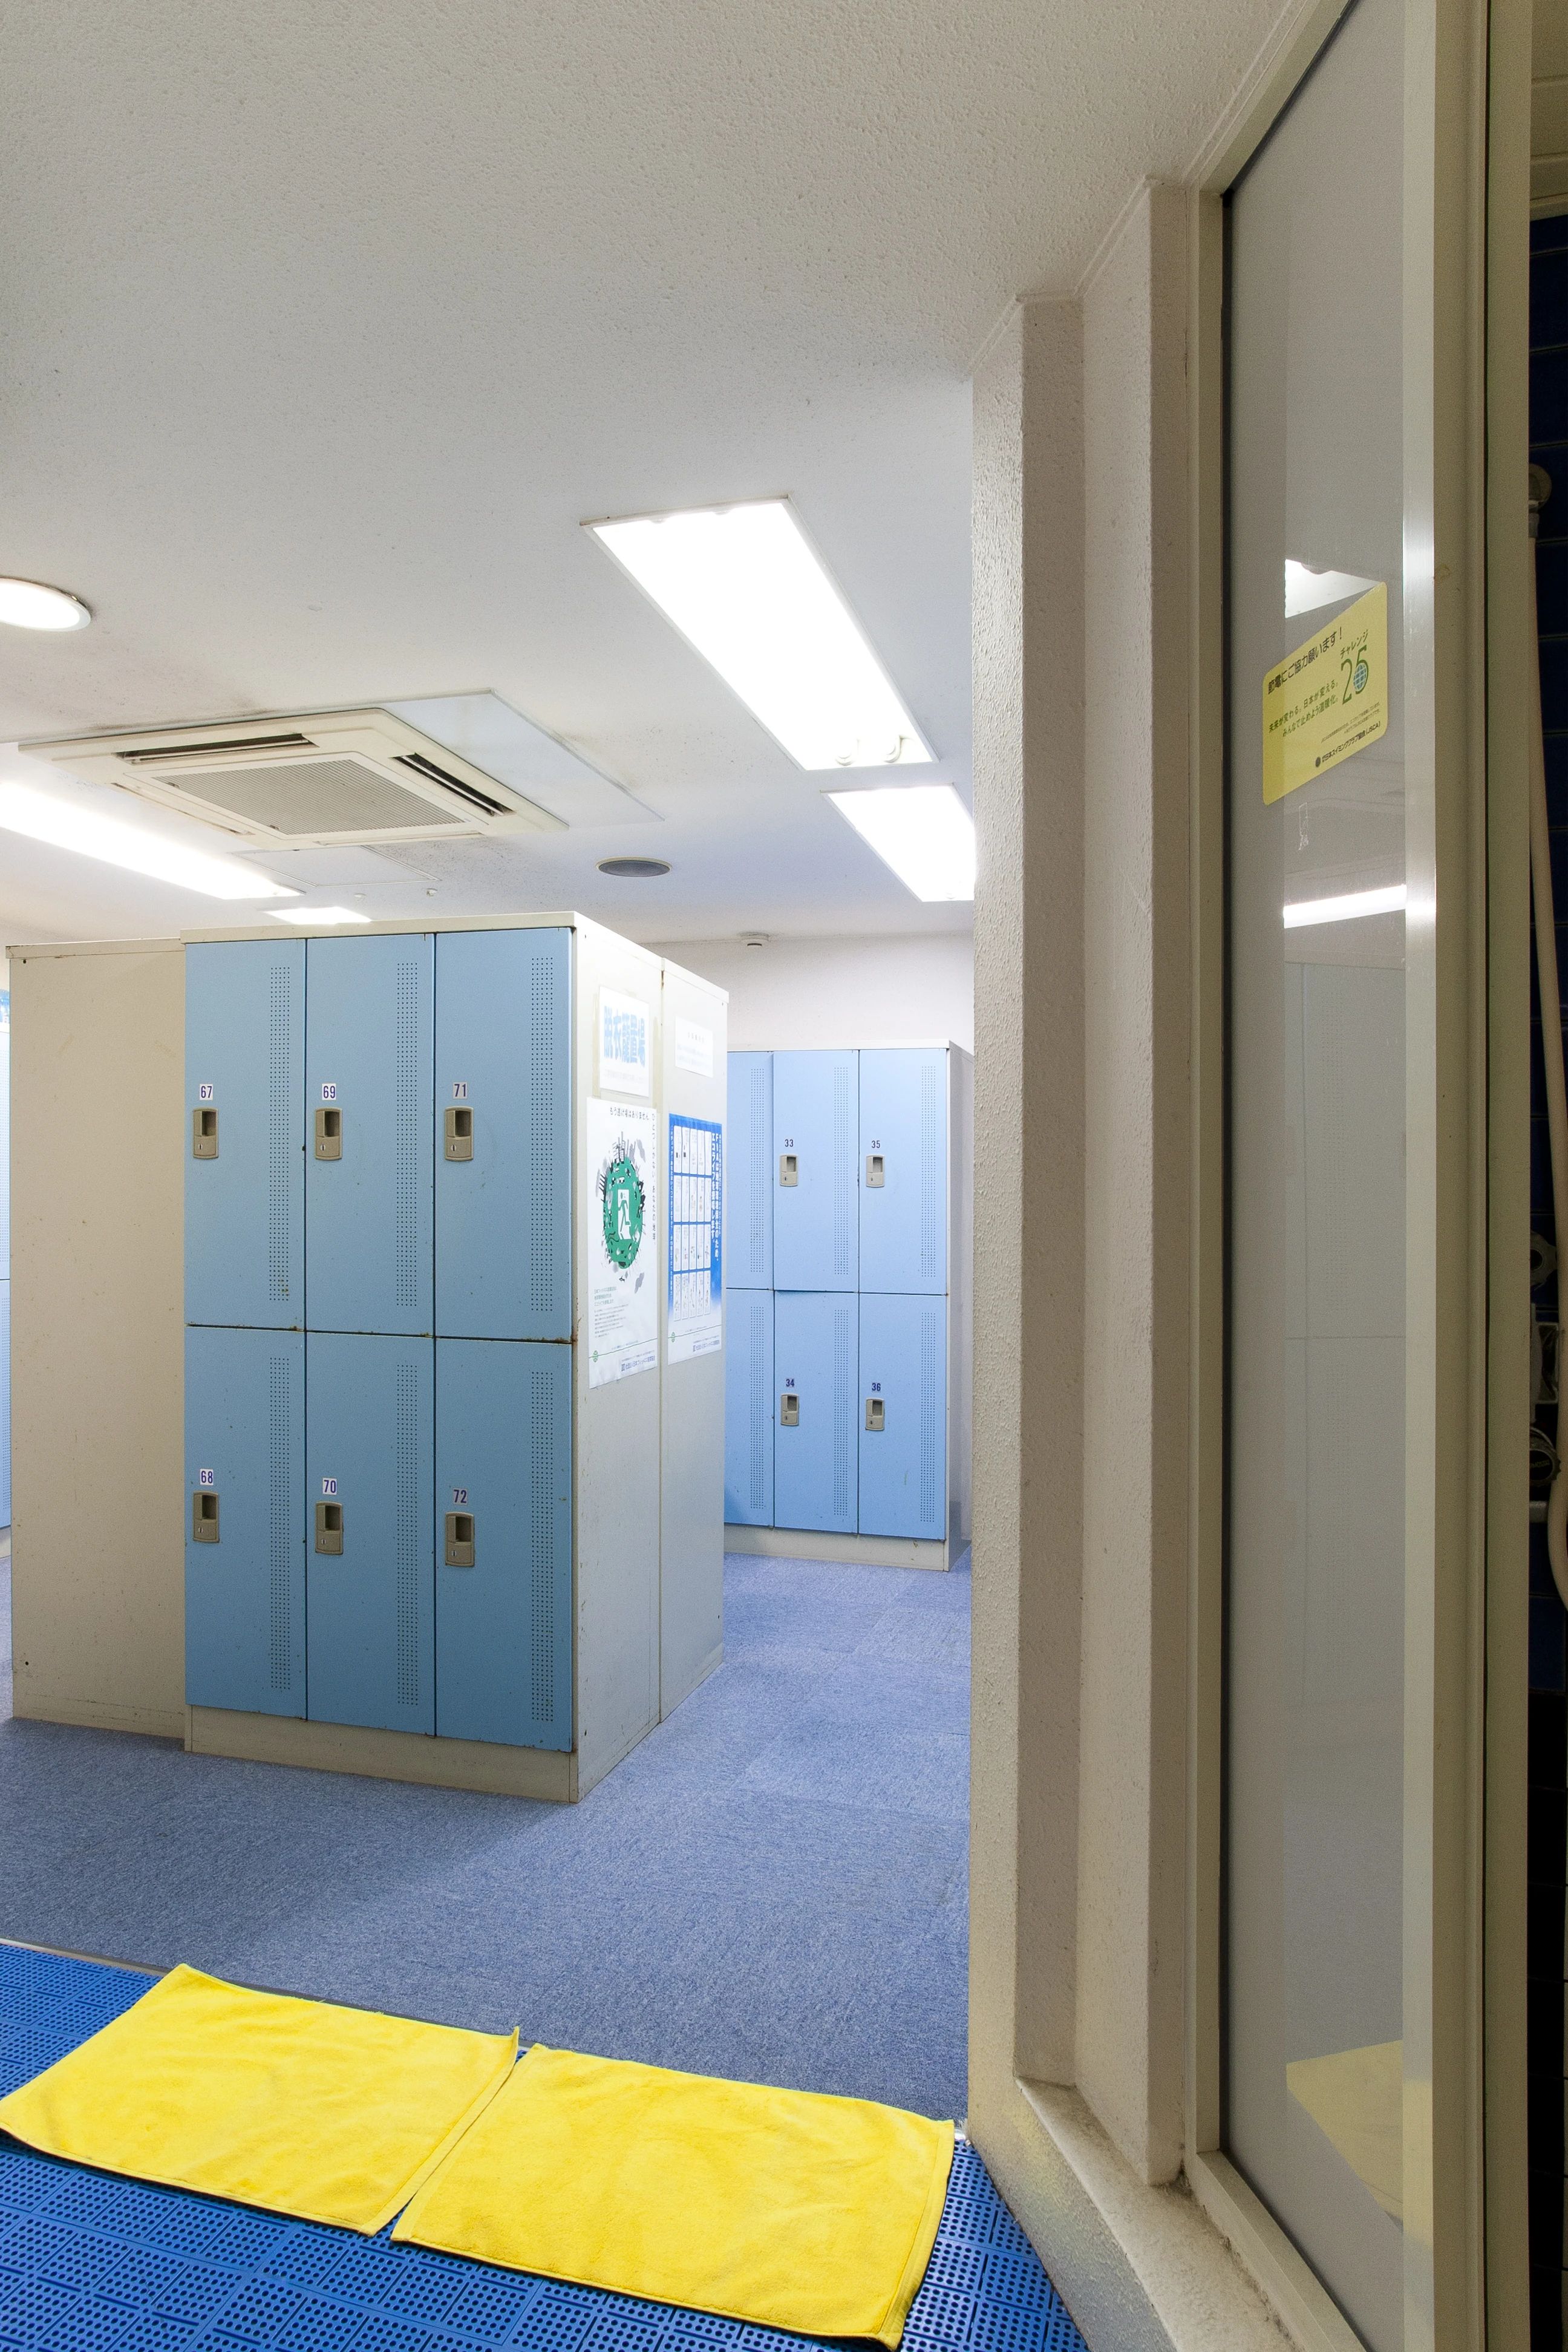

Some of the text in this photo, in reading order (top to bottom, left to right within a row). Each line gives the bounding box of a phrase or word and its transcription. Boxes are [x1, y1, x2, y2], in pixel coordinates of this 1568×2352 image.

[1339, 629, 1368, 658] チャレンジ
[1341, 644, 1369, 705] 25
[604, 1005, 645, 1068] 脱衣籠置場
[201, 1086, 212, 1098] 67
[324, 1086, 335, 1098] 69
[454, 1083, 466, 1097] 71
[201, 1471, 213, 1483] 68
[324, 1480, 336, 1493] 70
[454, 1489, 467, 1503] 72
